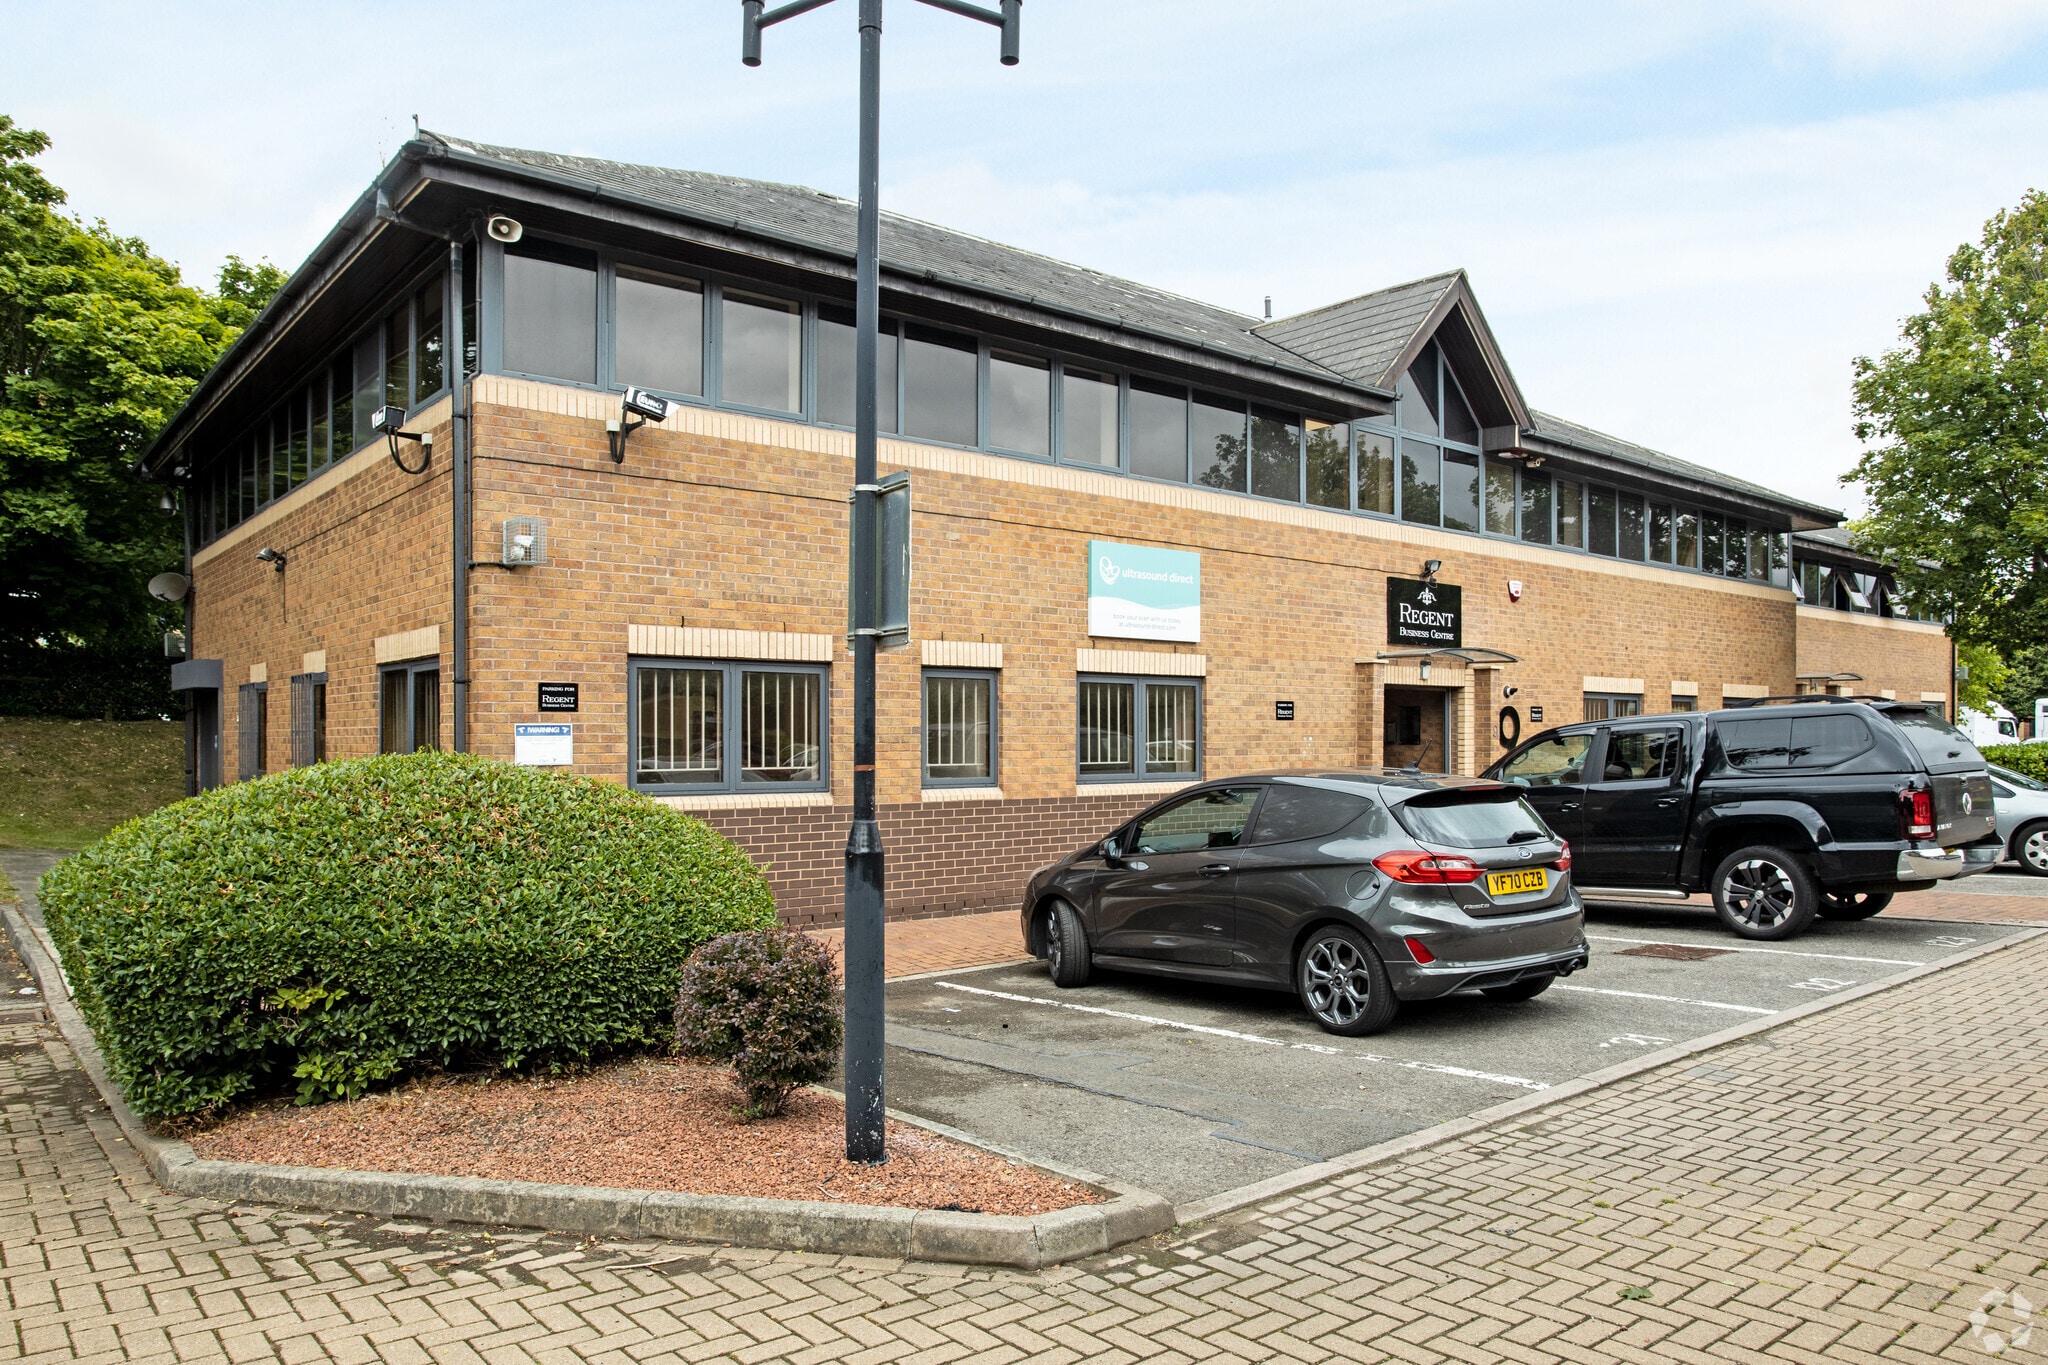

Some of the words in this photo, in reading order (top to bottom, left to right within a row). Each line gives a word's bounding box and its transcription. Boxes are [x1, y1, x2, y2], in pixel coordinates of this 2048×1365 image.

[1121, 568, 1168, 583] ultrasound
[1169, 572, 1194, 585] direct
[1399, 602, 1454, 627] REGENT
[1399, 627, 1429, 638] BUSINESS
[1431, 629, 1454, 640] CENTRE
[542, 694, 575, 703] REGENT
[1493, 873, 1522, 892] YF70
[1523, 871, 1544, 888] CZB
